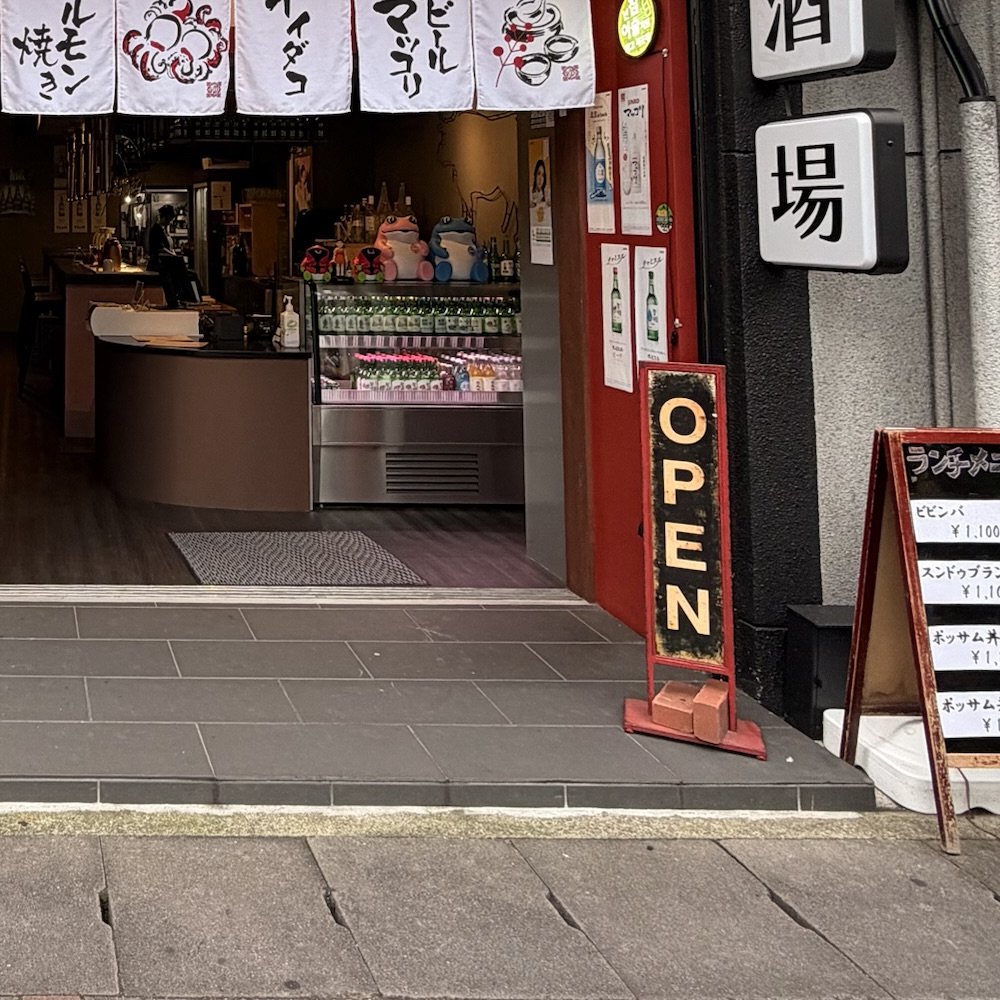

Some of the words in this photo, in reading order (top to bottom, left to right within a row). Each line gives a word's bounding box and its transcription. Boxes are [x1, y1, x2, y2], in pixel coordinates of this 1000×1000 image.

[12, 23, 60, 101] 焼き
[771, 142, 845, 243] 場
[658, 397, 712, 636] OPEN
[916, 504, 965, 518] ビビンバ
[971, 650, 1000, 666] ¥1,
[942, 697, 1000, 713] ポッサム
